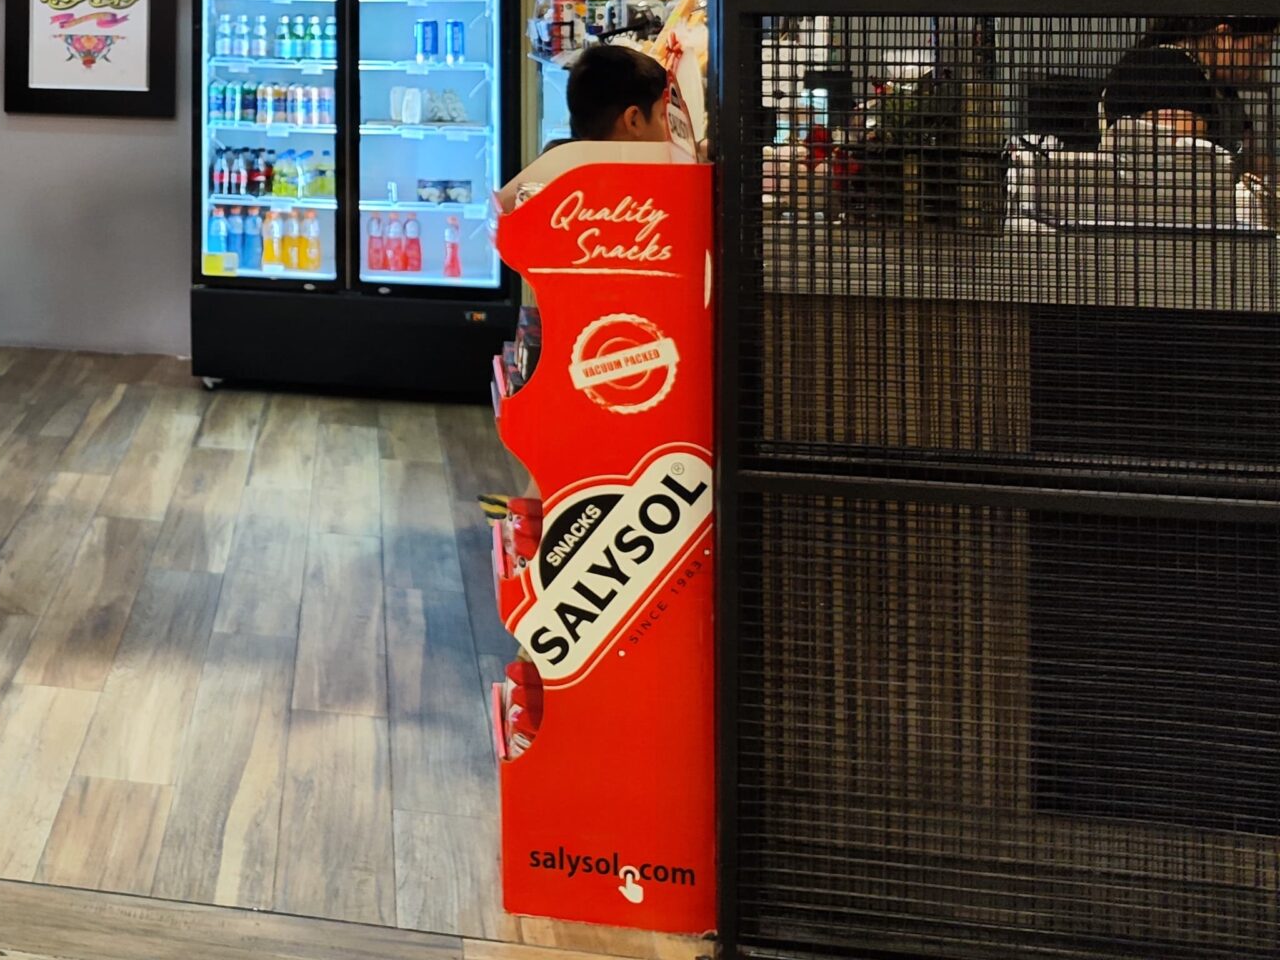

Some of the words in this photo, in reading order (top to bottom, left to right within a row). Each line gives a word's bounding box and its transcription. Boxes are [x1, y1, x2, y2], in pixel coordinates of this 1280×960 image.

[551, 191, 669, 242] Quality
[572, 228, 672, 265] Snacks
[583, 359, 622, 378] VACUUM
[624, 349, 660, 367] PACKED
[545, 504, 602, 567] SNACKS
[530, 474, 708, 666] SALYSOL
[629, 601, 668, 644] SINCE
[671, 560, 703, 594] 1983
